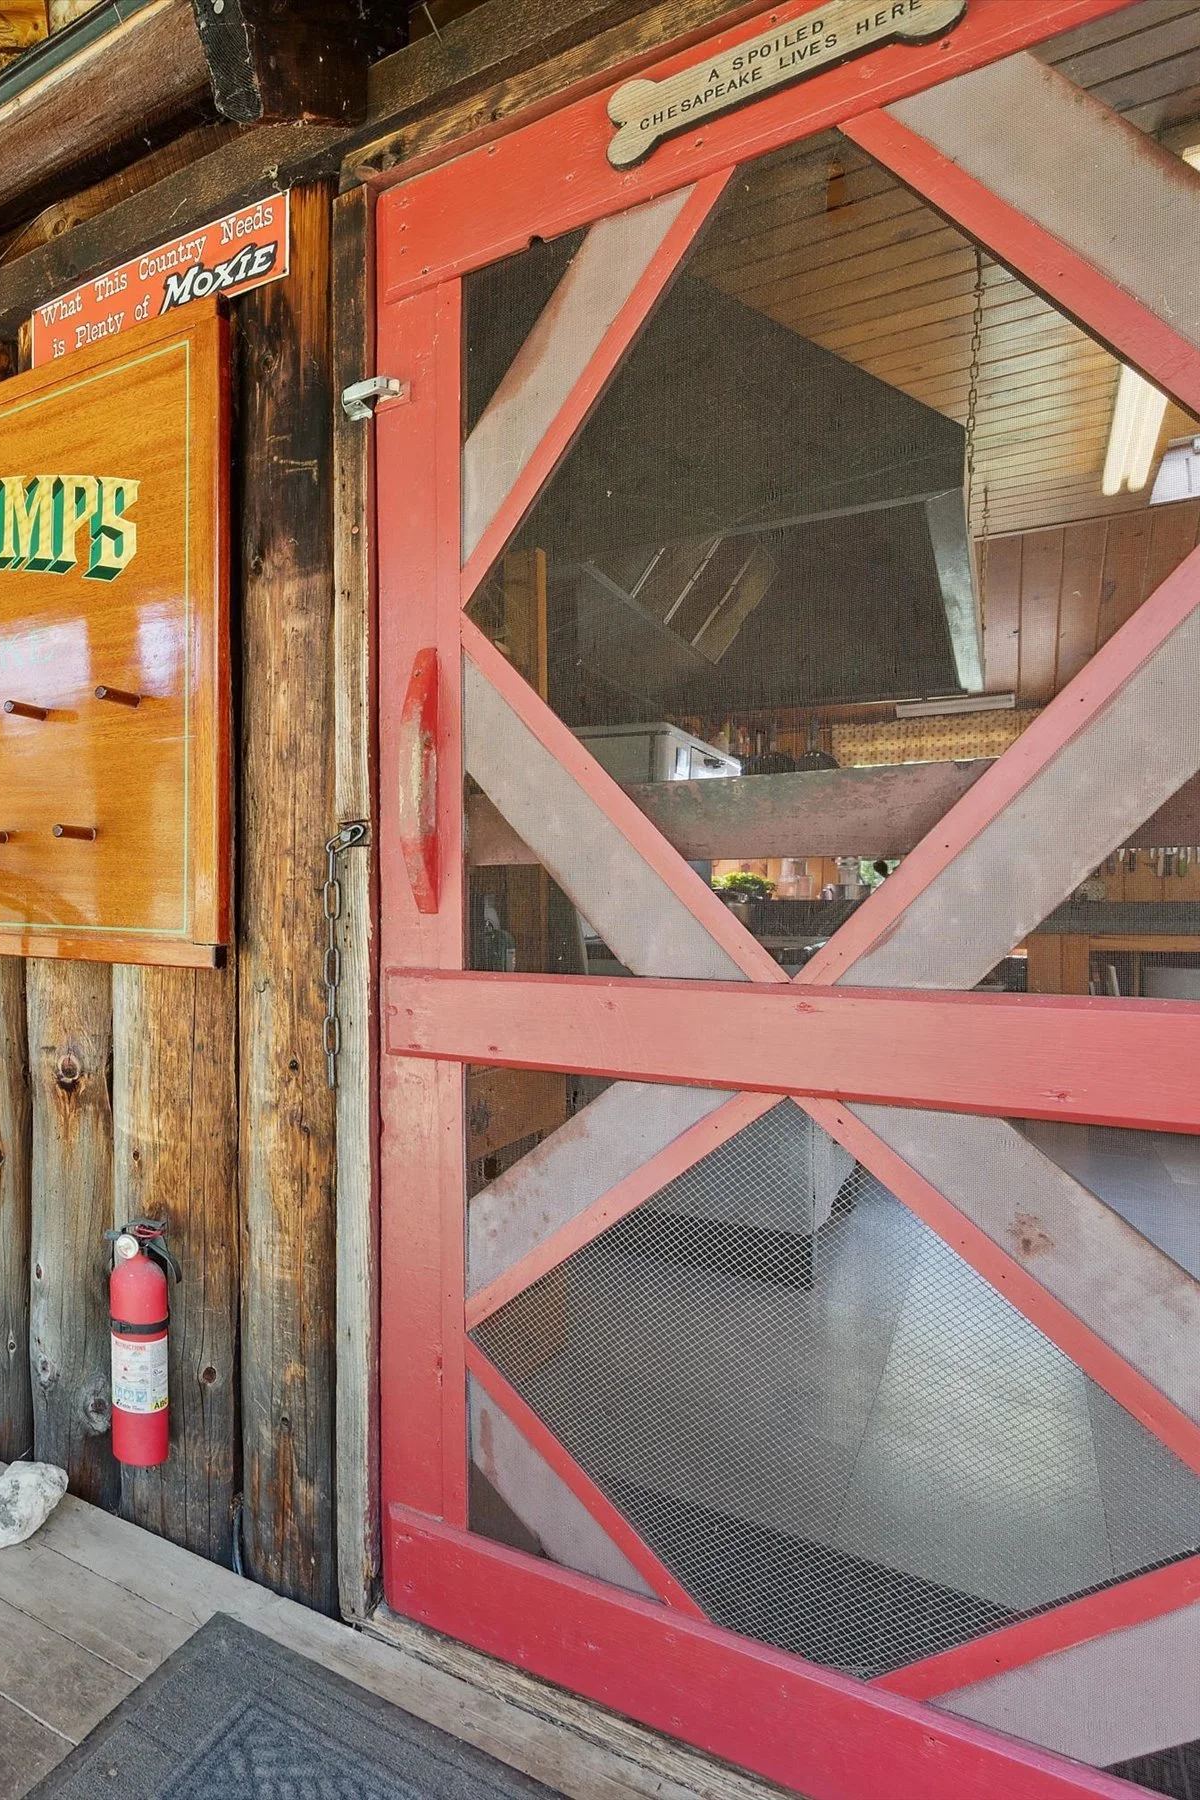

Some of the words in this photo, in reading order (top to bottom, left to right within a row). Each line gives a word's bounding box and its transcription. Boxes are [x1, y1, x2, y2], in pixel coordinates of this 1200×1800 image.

[639, 67, 762, 131] CHESAPEAKE
[779, 35, 837, 70] LIVES
[856, 0, 922, 35] HERE
[707, 69, 720, 83] A
[732, 20, 824, 71] SPOILED
[41, 293, 82, 327] What
[94, 272, 128, 303] This
[139, 236, 207, 281] Country
[220, 205, 273, 246] Needs
[53, 339, 65, 358] is
[75, 311, 125, 349] Plenty
[134, 295, 151, 321] of
